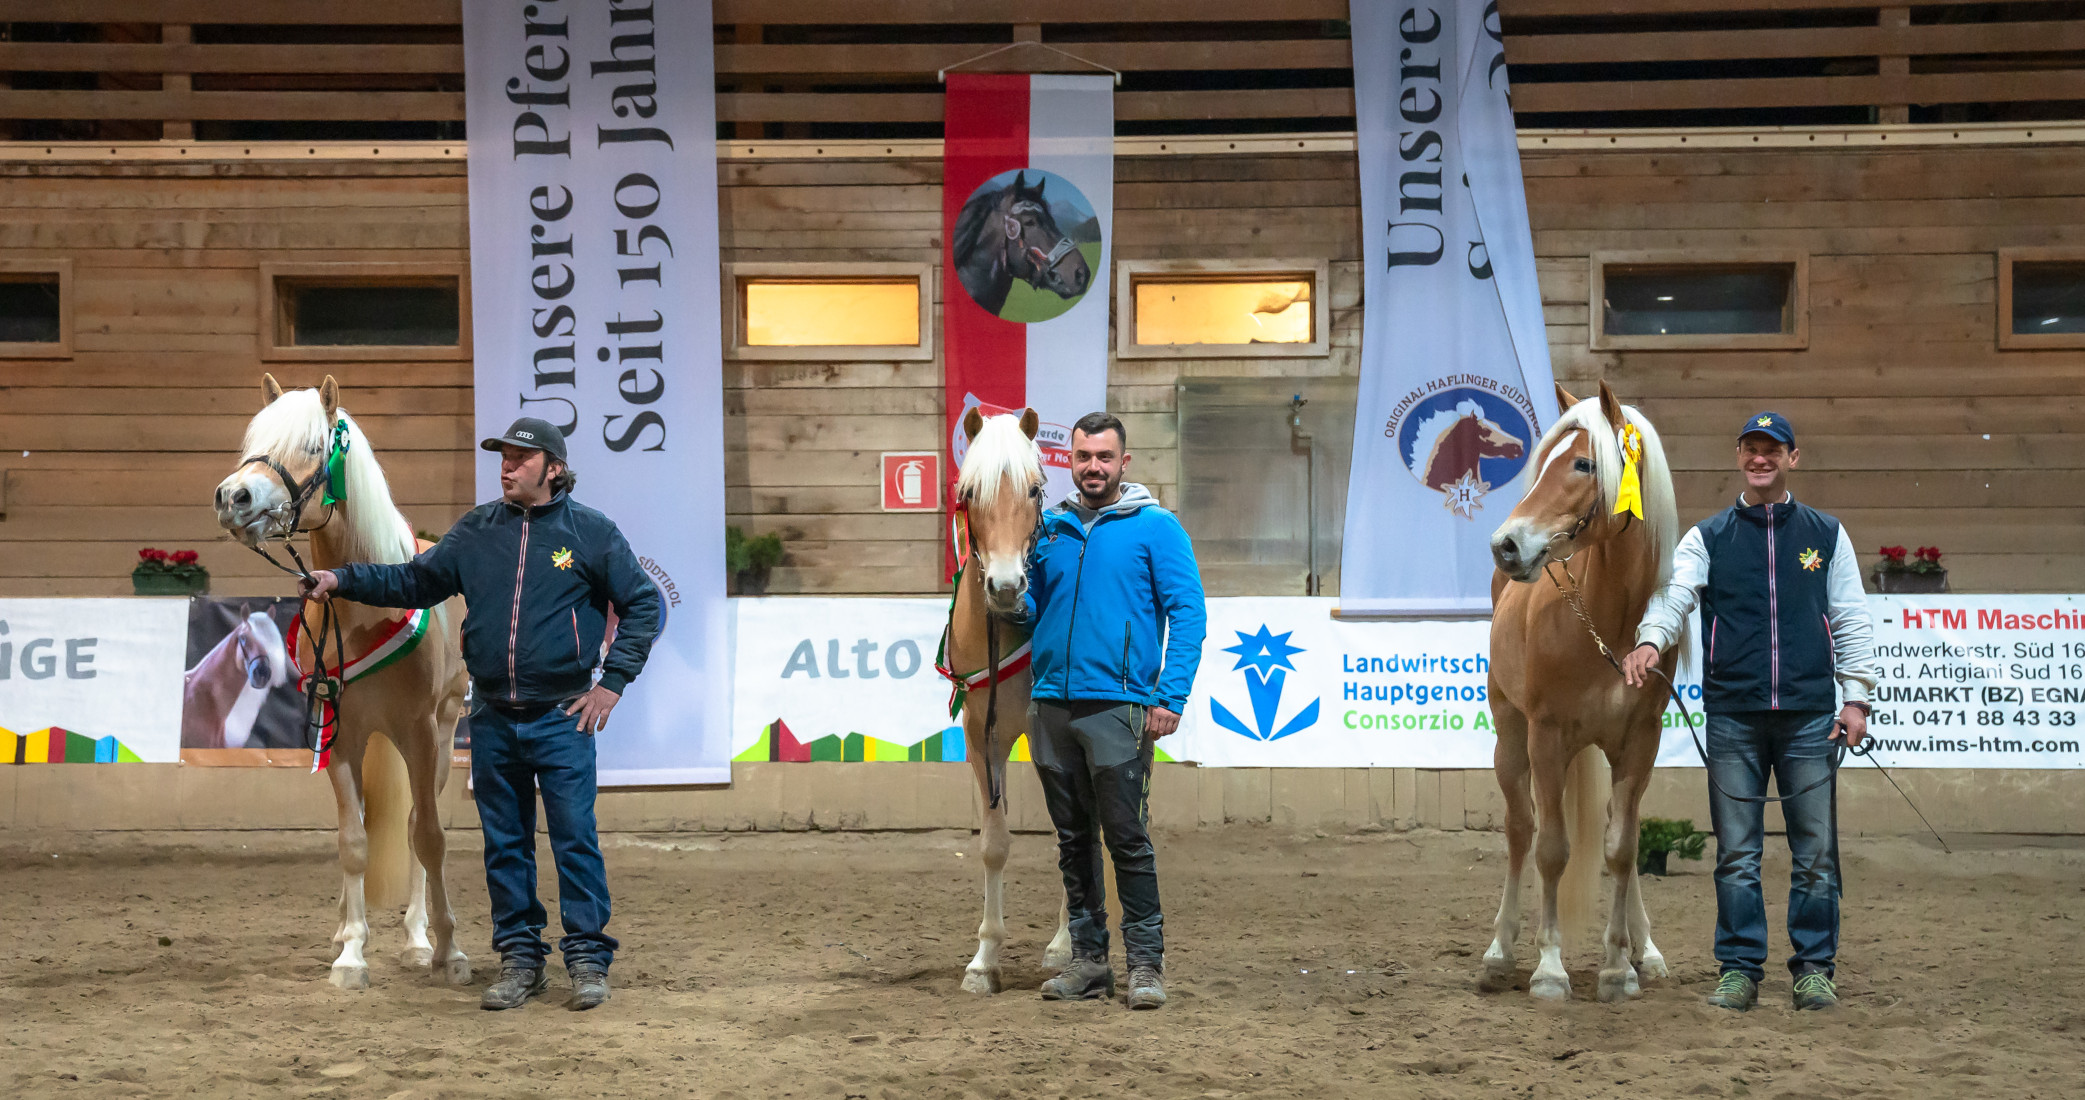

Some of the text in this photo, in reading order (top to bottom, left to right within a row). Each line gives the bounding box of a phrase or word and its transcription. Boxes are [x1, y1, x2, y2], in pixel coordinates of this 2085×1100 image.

[1387, 8, 1445, 274] Unsere
[613, 172, 674, 290] 150
[520, 183, 577, 438] Unsere
[597, 311, 666, 453] Seit
[1384, 387, 1426, 438] ORIGINAL
[1426, 374, 1498, 393] HAFLINGER
[1459, 489, 1470, 501] H
[638, 556, 682, 608] SÜDTIROL
[1902, 608, 1967, 630] HTM
[1977, 608, 2085, 630] Maschi
[2013, 641, 2055, 659] Süd
[1343, 653, 1489, 674] Landwirtsch
[1893, 663, 1911, 679] d.
[1918, 663, 2003, 683] Artigiani
[2010, 663, 2051, 679] Sud
[2058, 664, 2083, 679] 16
[1343, 682, 1487, 705] Hauptgenos
[1981, 686, 2024, 706] (BZ)
[1343, 709, 1464, 731] Consorzio
[1871, 709, 2077, 727] Tel. 0471 88 43 33
